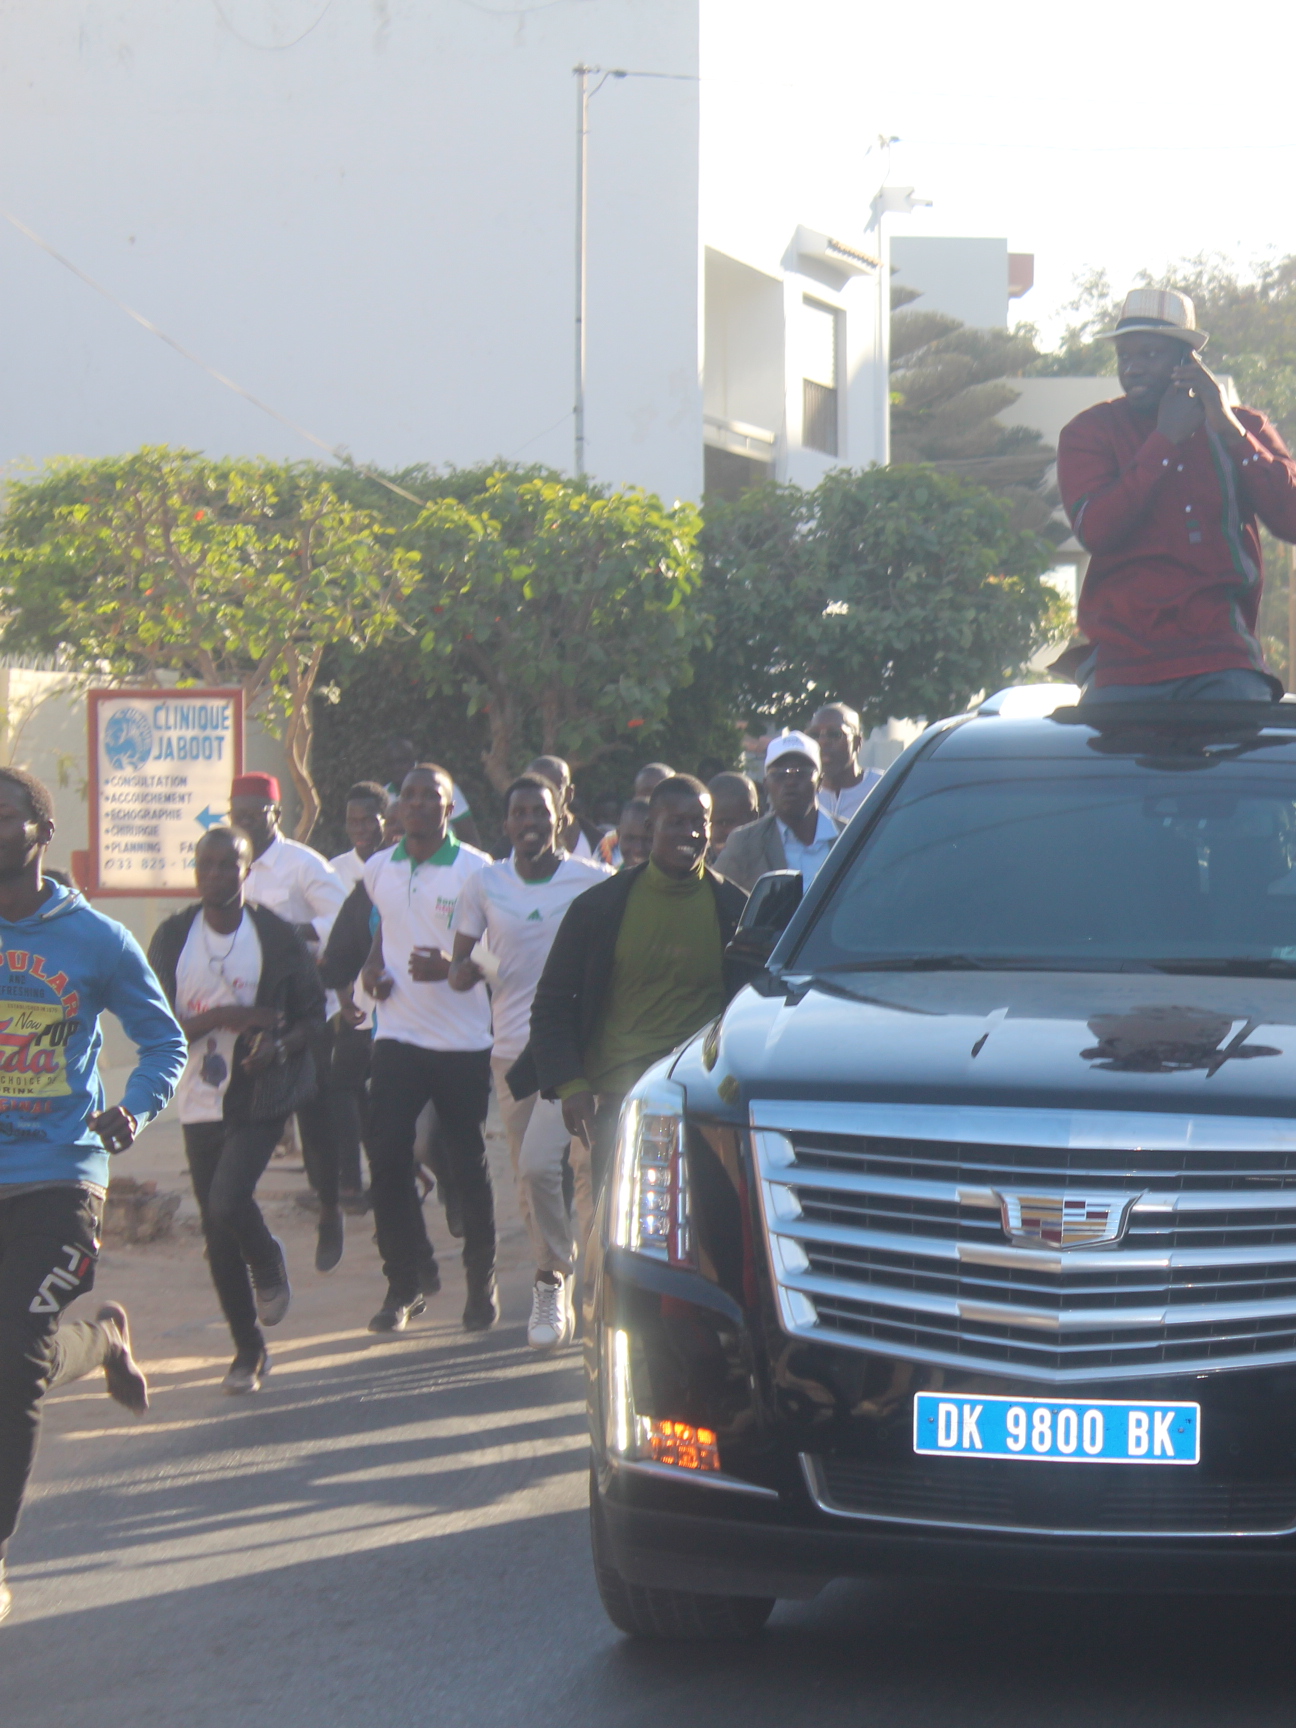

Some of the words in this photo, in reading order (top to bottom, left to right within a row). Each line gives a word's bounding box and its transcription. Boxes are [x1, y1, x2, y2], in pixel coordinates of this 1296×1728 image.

[153, 705, 230, 732] CLINIQUE
[152, 736, 225, 761] JABOOT
[109, 775, 188, 787] CONSULTATION
[110, 791, 192, 804] ACCOUCHEMENT
[110, 808, 182, 821] ECHOGRAPHIE
[110, 824, 160, 837] CHIRURGIE
[110, 841, 161, 853] PLANNING
[0, 985, 45, 998] FRESHING
[15, 1010, 42, 1030] Now
[34, 1021, 80, 1047] POP
[1, 1076, 41, 1086] CHOICE
[0, 1086, 34, 1094] RINK
[29, 1245, 91, 1313] FILA
[937, 1402, 983, 1449] DK
[1006, 1406, 1104, 1455] 9800
[1128, 1410, 1176, 1456] BK
